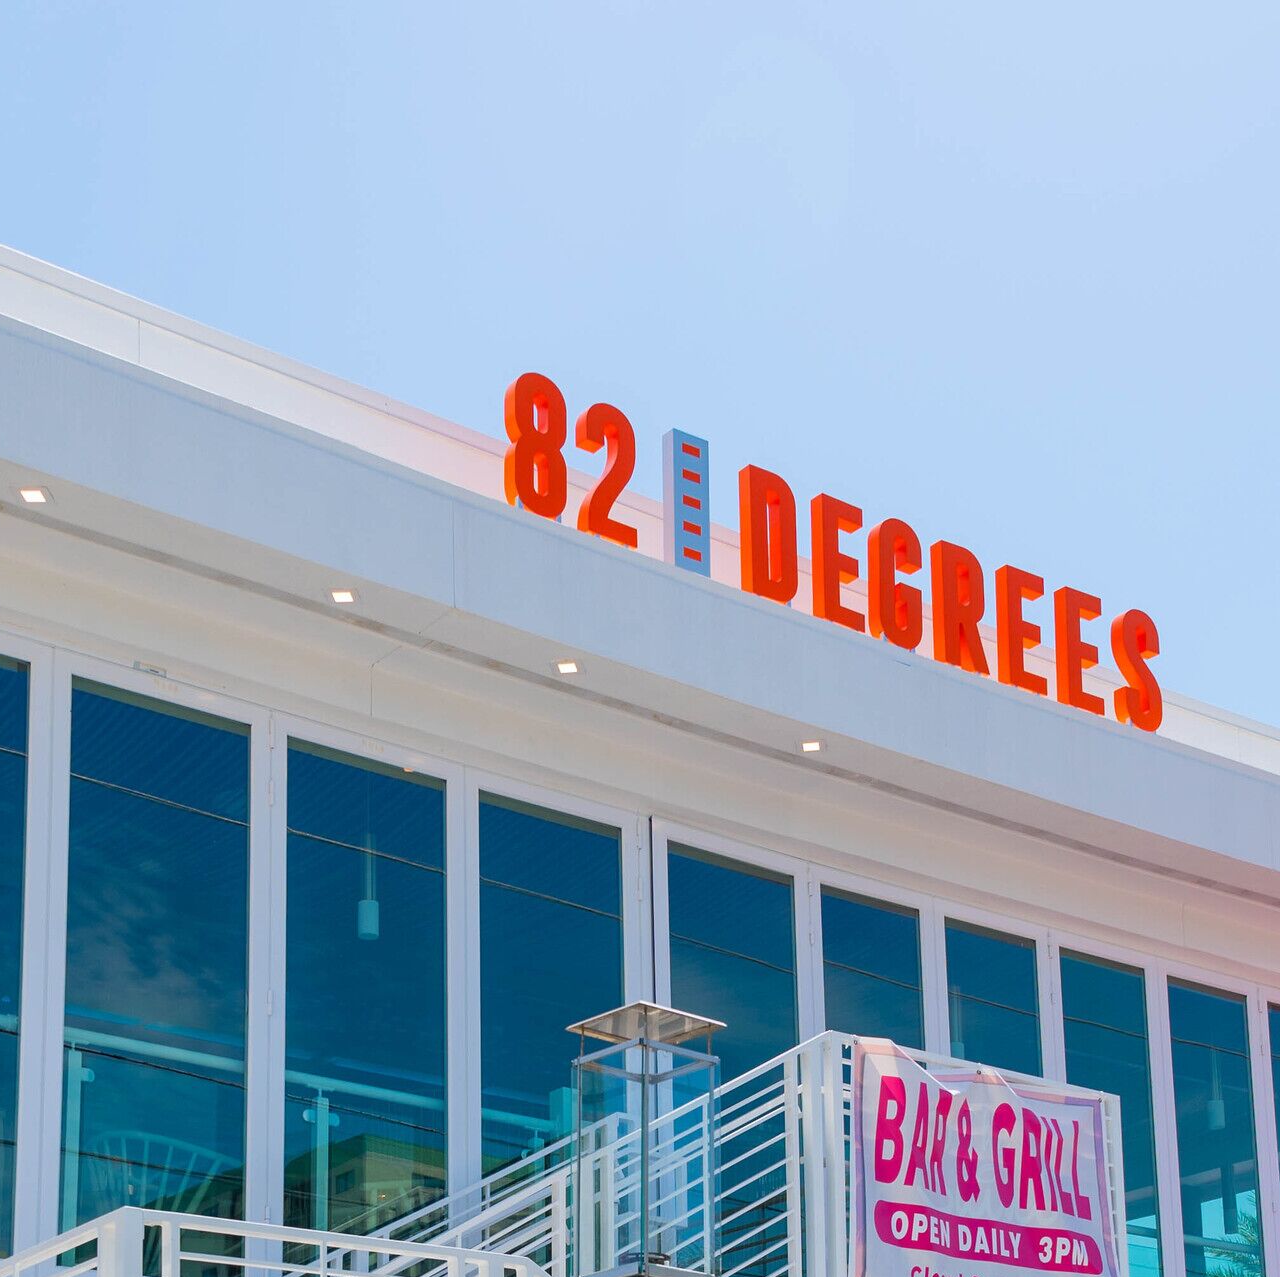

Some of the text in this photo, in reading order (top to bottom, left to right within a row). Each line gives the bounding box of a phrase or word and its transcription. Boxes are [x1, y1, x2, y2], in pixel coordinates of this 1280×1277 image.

[504, 372, 1163, 732] 82 DEGREES
[875, 1075, 1092, 1221] BAR & GRILL
[890, 1210, 1090, 1267] OPEN DAILY 3PM
